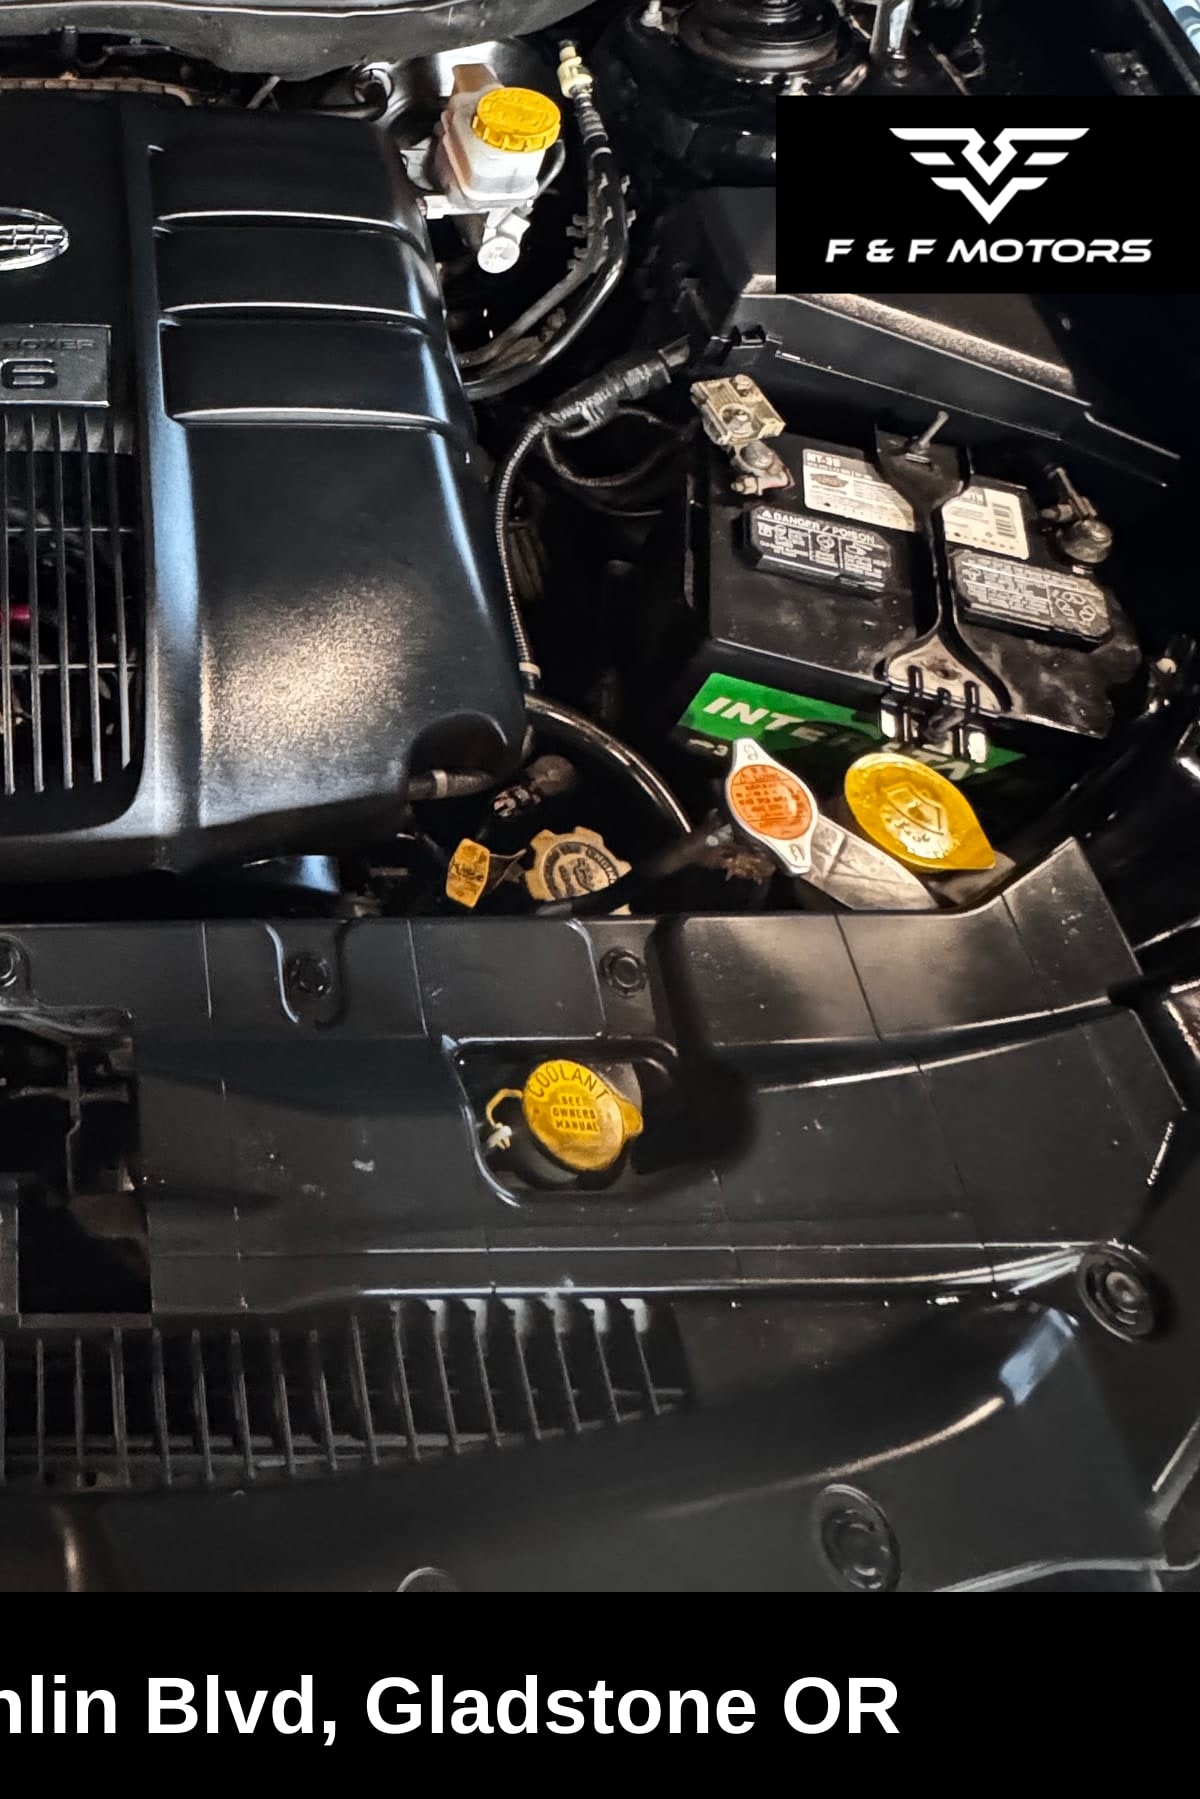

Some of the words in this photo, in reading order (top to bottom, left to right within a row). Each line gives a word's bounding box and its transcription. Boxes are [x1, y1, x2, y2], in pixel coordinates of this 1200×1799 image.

[773, 510, 821, 531] DANGER
[832, 527, 875, 545] POISON
[528, 1063, 609, 1101] COOLANT
[561, 1095, 583, 1106] SEE
[552, 1107, 597, 1120] OWNERS
[555, 1119, 600, 1132] MANUAL
